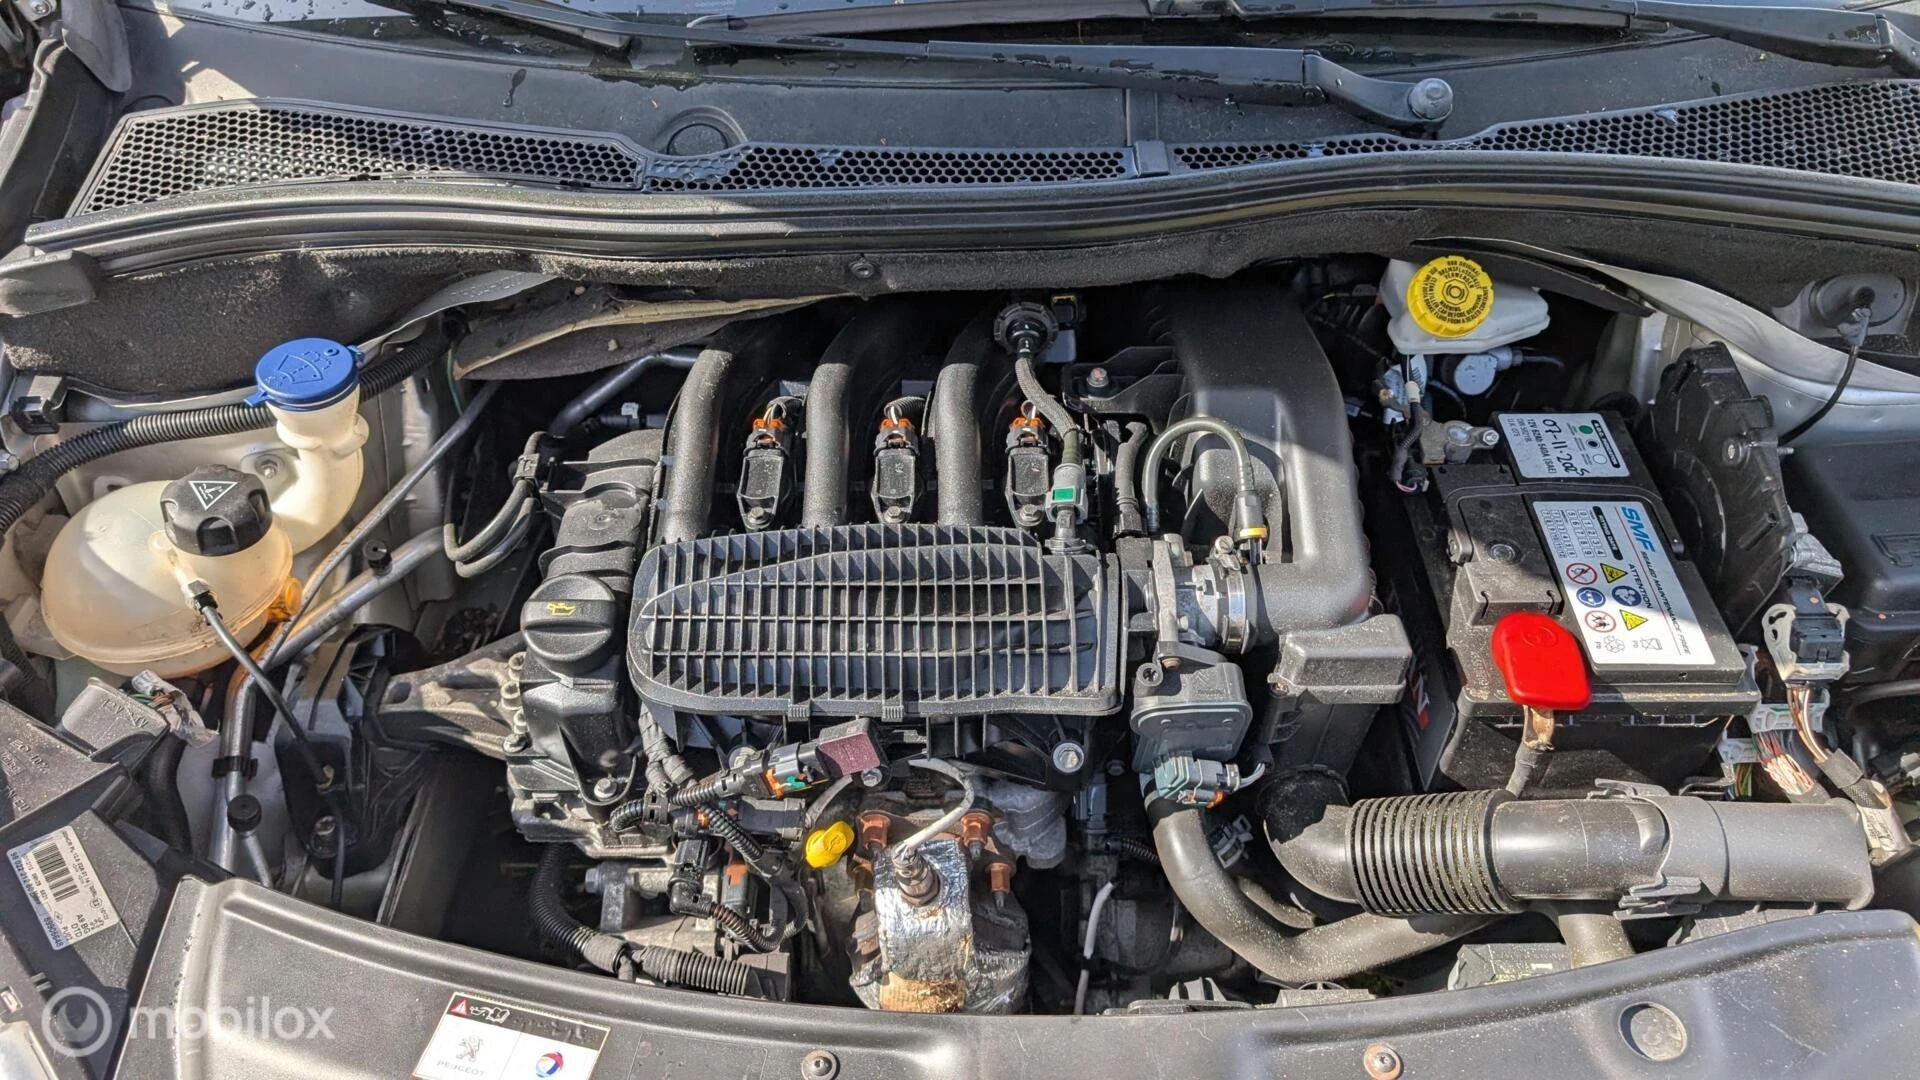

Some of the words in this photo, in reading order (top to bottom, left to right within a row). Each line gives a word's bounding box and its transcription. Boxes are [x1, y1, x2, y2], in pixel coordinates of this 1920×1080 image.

[1621, 506, 1656, 552] SMF
[1627, 563, 1653, 608] ATTENTION
[1640, 551, 1657, 577] SEALED
[1652, 579, 1681, 631] MAINTENANCE
[1676, 634, 1691, 654] FREE
[70, 922, 83, 938] DTD
[437, 1059, 485, 1077] PEUGEOT
